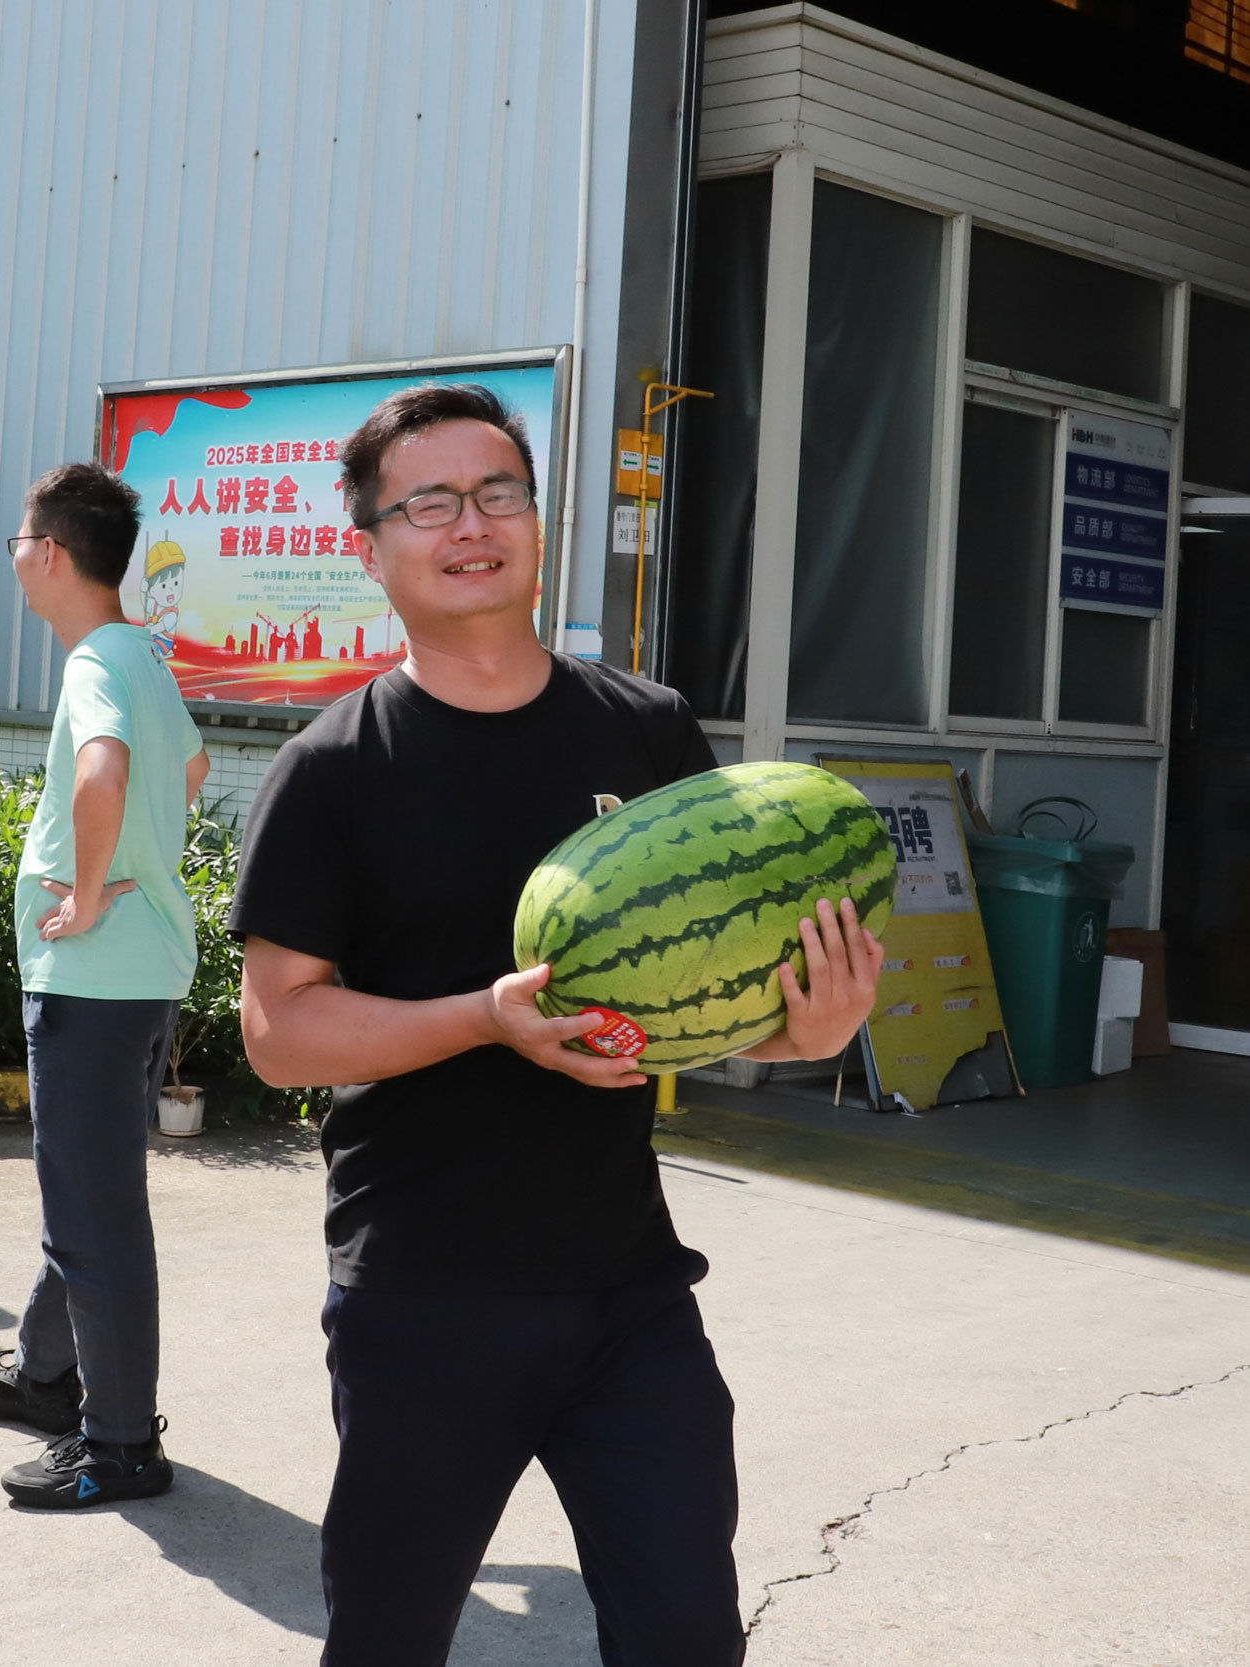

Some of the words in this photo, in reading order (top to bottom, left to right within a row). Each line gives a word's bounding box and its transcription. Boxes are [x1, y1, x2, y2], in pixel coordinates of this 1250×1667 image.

[206, 439, 340, 466] 2025年全国安全生
[1077, 464, 1116, 490] 物流部
[1074, 515, 1114, 539] 品质部
[219, 524, 360, 557] 查找身边安全
[1071, 566, 1111, 590] 安全部
